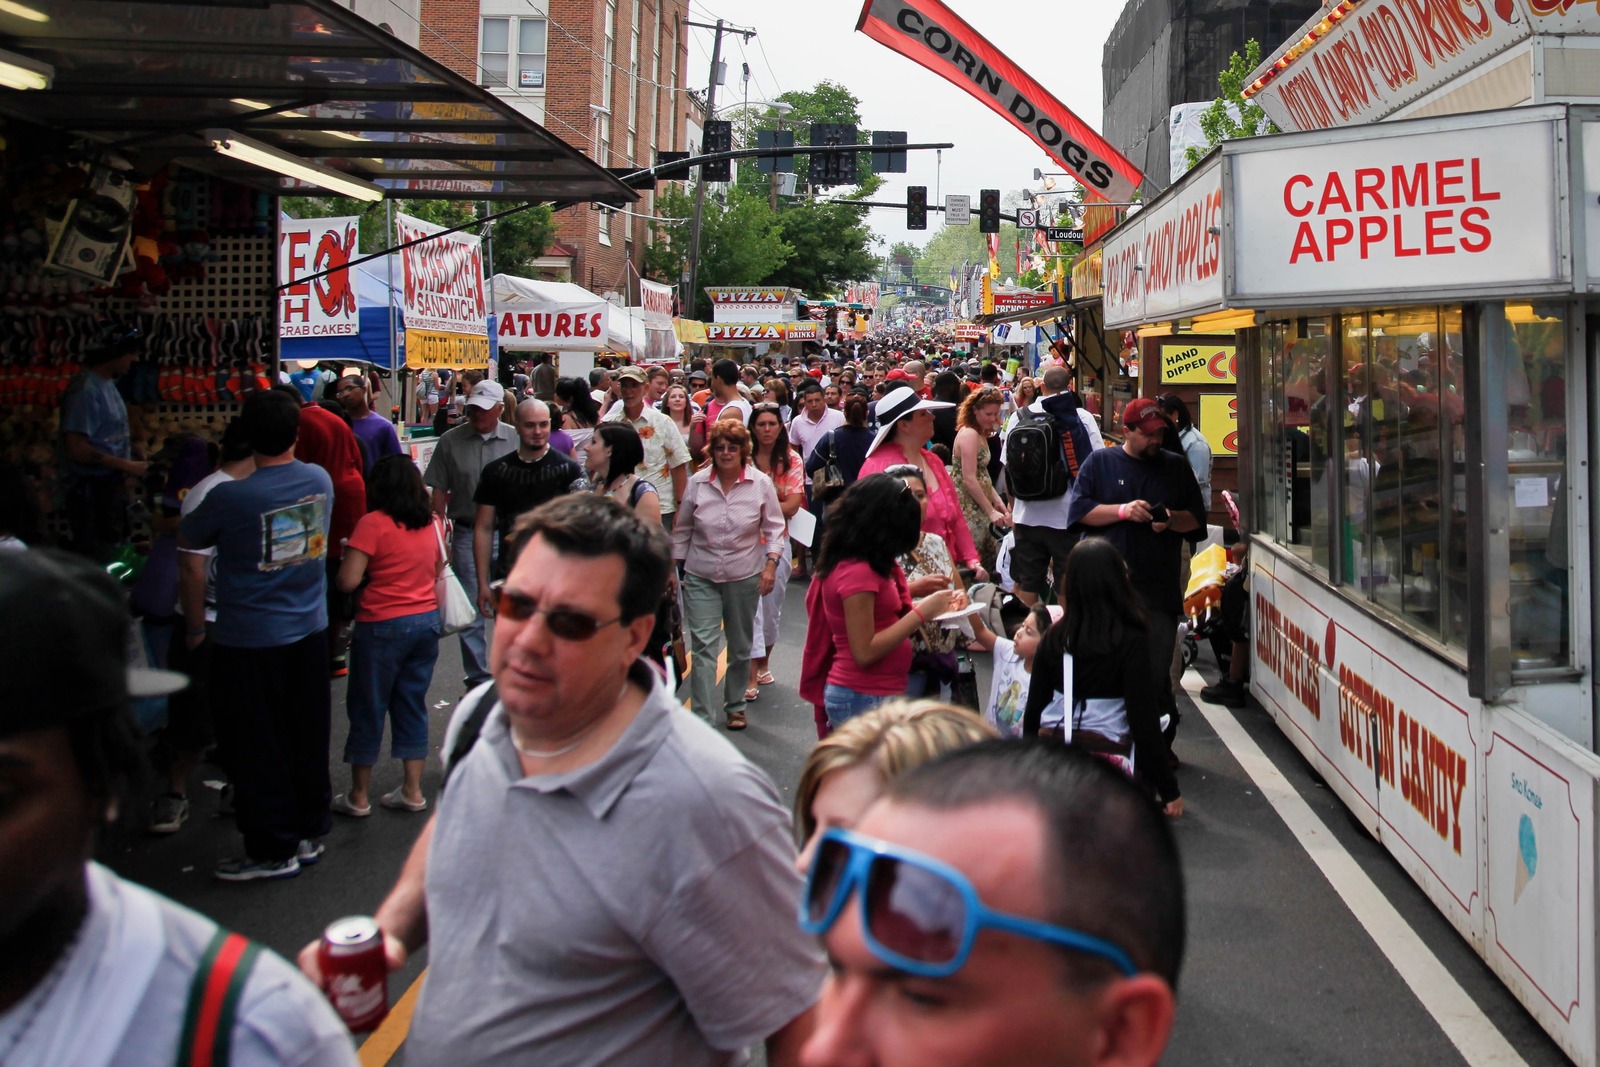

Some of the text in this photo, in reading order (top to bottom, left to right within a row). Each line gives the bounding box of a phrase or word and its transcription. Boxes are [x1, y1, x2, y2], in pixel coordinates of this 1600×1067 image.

[1312, 30, 1381, 121] CANDY
[896, 8, 1003, 96] CORN
[1008, 93, 1113, 189] DOGS
[1283, 158, 1501, 217] CARMEL
[1144, 218, 1176, 295] CANDY
[1176, 187, 1222, 286] APPLES
[1289, 206, 1492, 264] APPLES
[417, 292, 476, 321] SANDWICH
[717, 292, 779, 302] PIZZA
[280, 325, 310, 336] CRAB
[708, 325, 780, 339] PIZZA
[789, 331, 815, 339] DRINKS
[421, 336, 438, 363] ICED
[455, 339, 489, 364] LEMONADE
[1165, 348, 1199, 366] HAND
[1166, 357, 1207, 379] DIPPED
[1256, 591, 1321, 722] CANDY APPLES
[1338, 661, 1467, 858] COTTON CANDY
